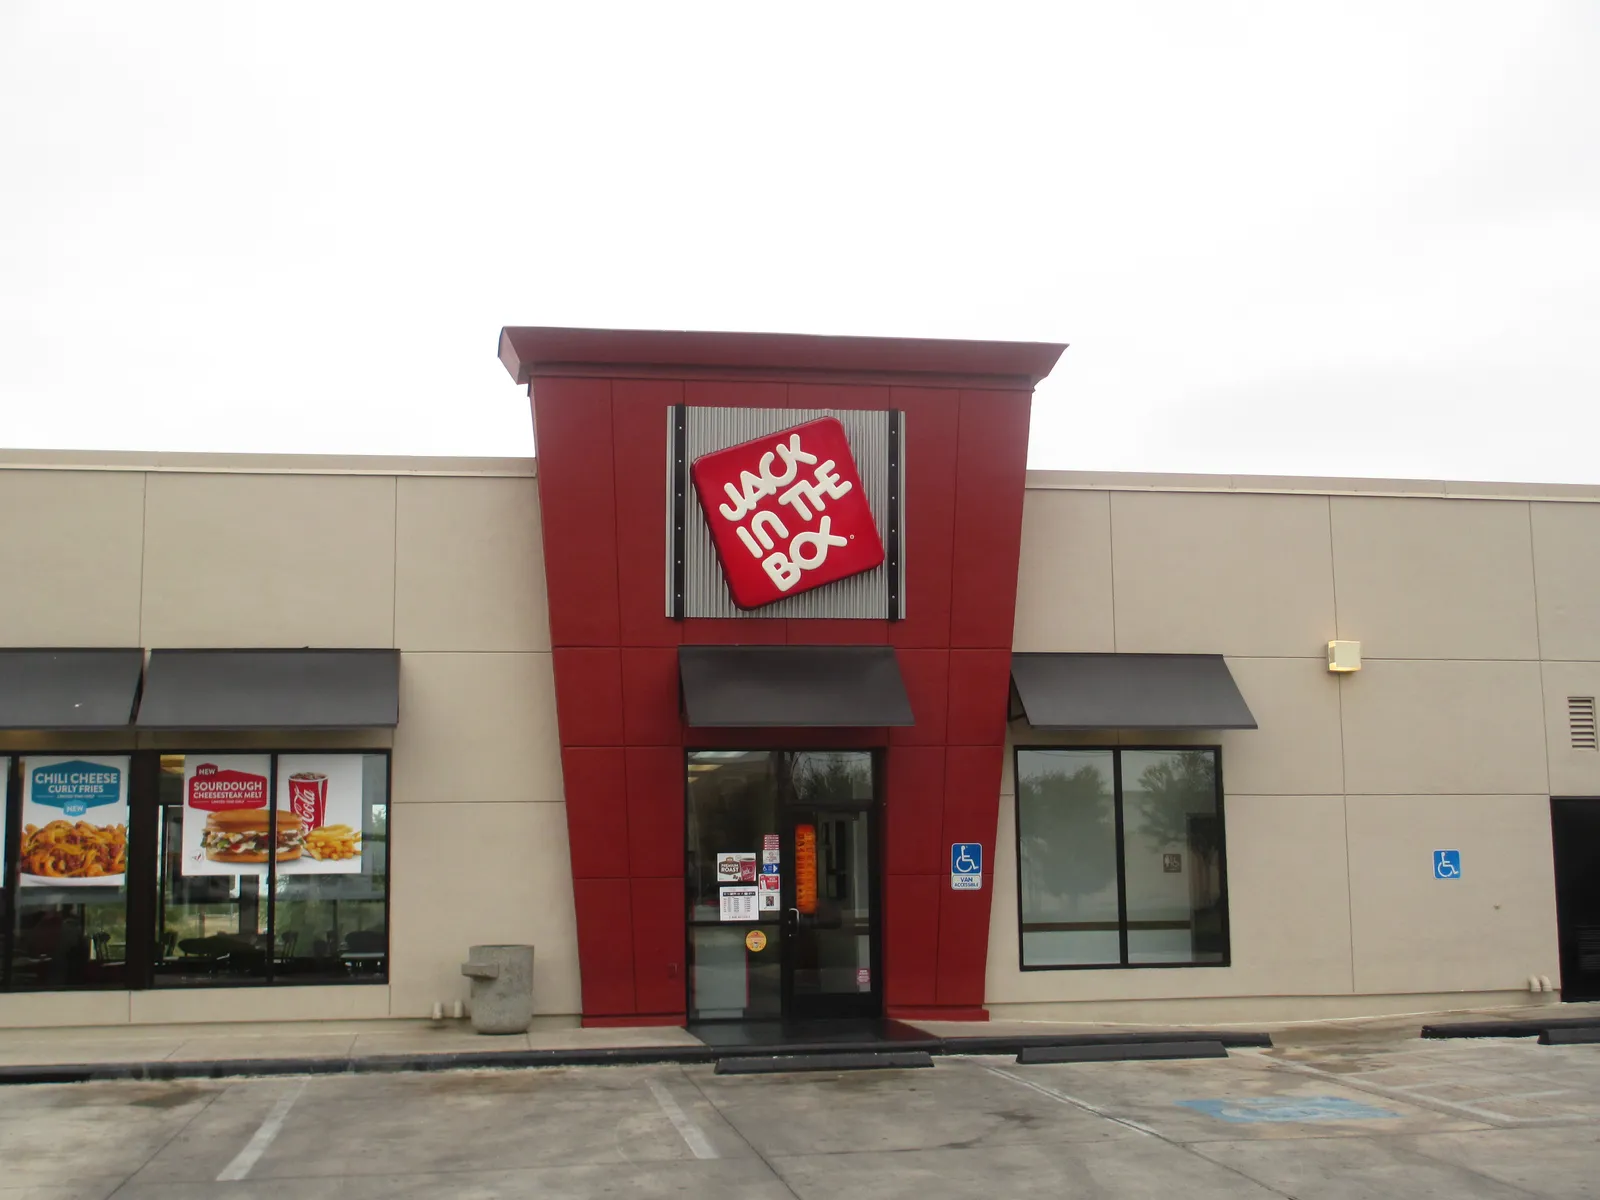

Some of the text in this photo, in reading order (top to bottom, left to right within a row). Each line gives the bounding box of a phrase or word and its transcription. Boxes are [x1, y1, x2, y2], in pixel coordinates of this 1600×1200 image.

[718, 433, 818, 522] JACK
[778, 459, 853, 521] THE
[761, 515, 848, 592] BOX
[35, 772, 118, 784] CHILI CHEESE
[48, 784, 104, 793] CURLY FRIES
[193, 781, 262, 791] SOURDOUGH
[193, 791, 263, 799] CHEESESTEAK MELT
[66, 805, 84, 813] NEW
